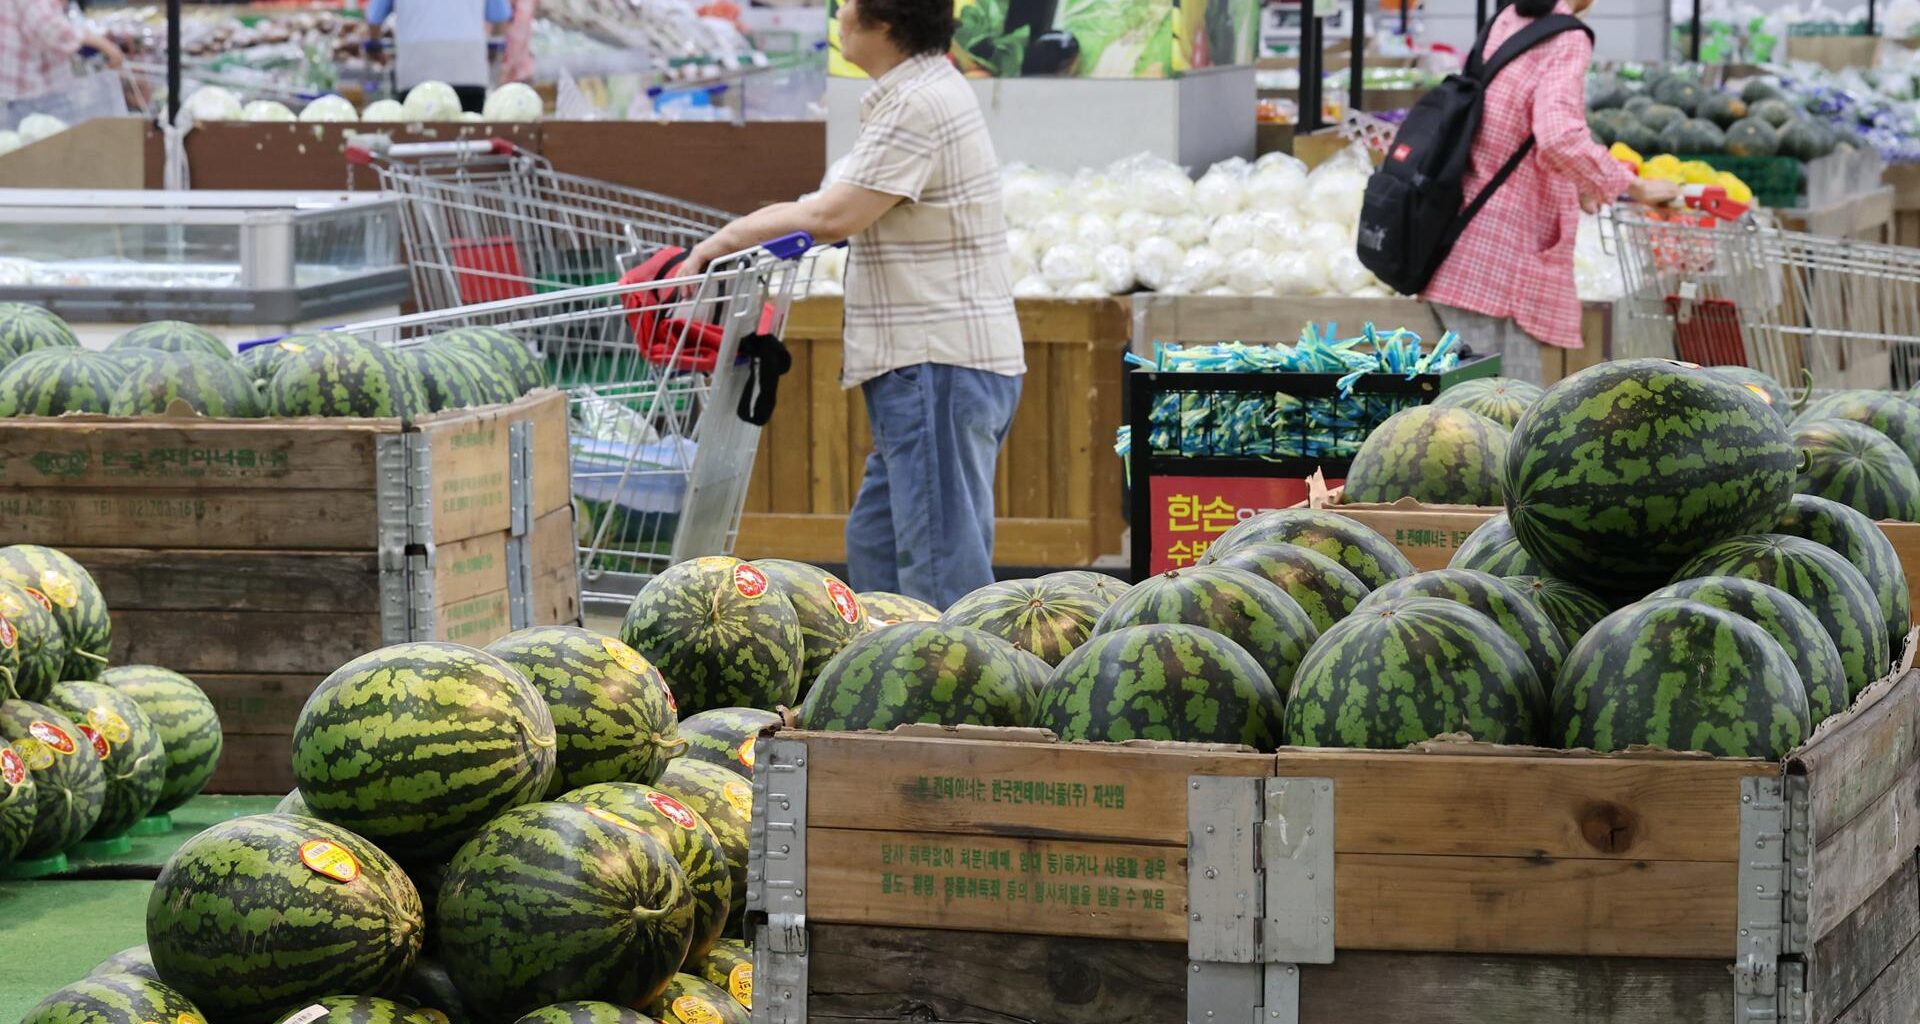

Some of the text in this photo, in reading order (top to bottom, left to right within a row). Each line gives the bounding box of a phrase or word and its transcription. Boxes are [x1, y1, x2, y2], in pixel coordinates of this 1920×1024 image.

[1093, 783, 1126, 809] 재산임
[910, 845, 954, 869] 허락없이
[1047, 853, 1099, 876] 등)하거나
[1104, 856, 1138, 879] 사용할
[1144, 858, 1167, 880] 경우
[1007, 880, 1029, 903] 등의
[1098, 886, 1120, 908] 받을
[1126, 887, 1137, 908] 수
[1142, 889, 1165, 910] 있음
